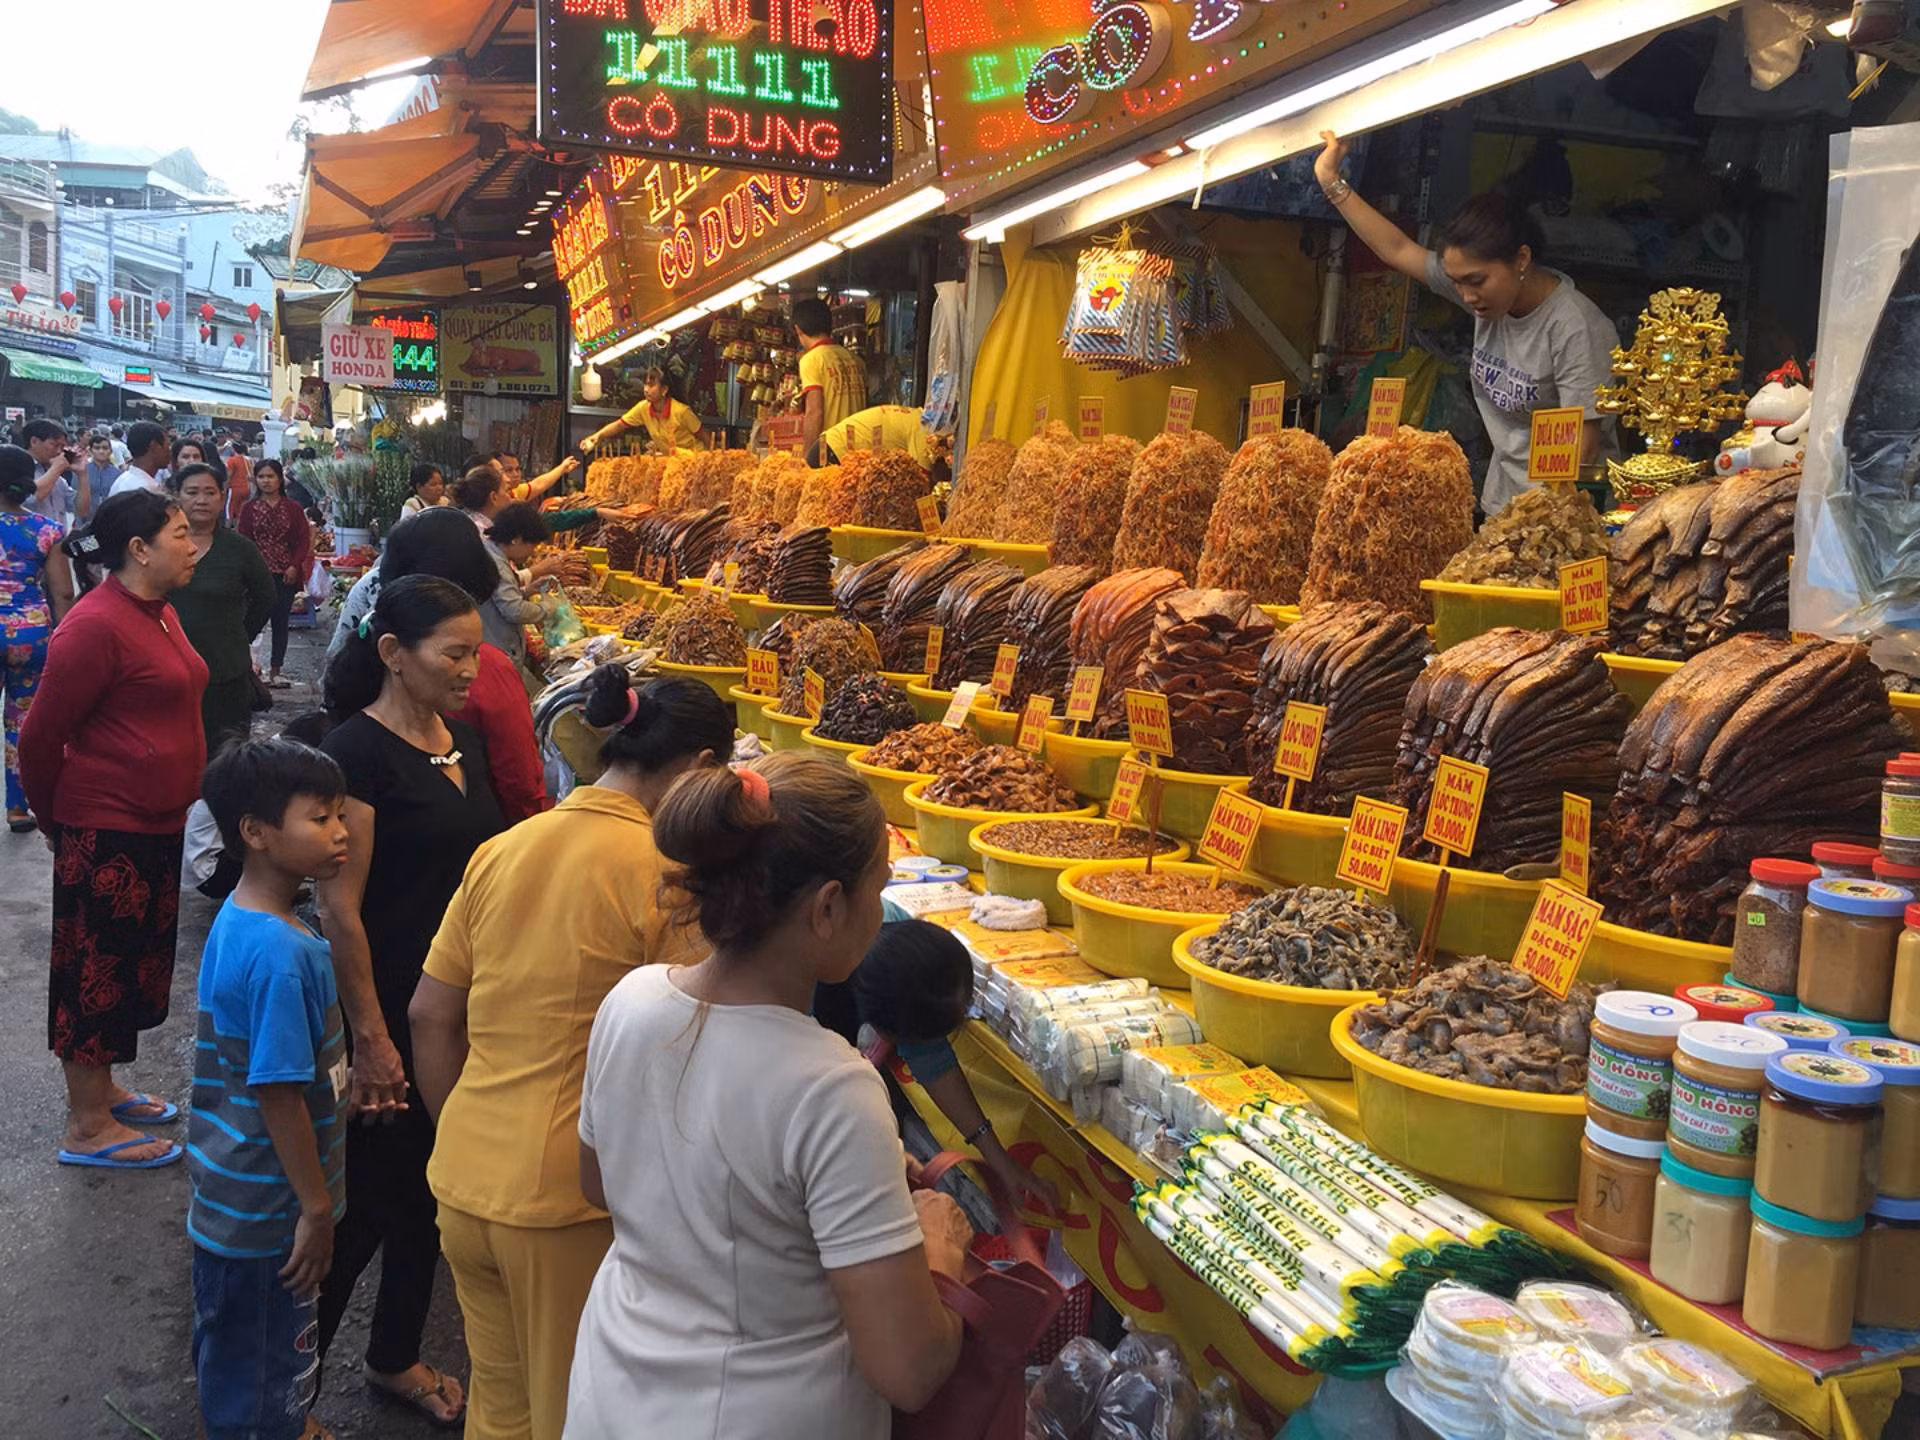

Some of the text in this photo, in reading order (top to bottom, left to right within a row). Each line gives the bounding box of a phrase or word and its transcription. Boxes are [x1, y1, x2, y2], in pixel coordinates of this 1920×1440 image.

[608, 90, 842, 159] CÔ DUNG
[658, 209, 696, 289] CÔ
[364, 337, 386, 360] XE
[331, 361, 386, 378] HONDA
[1474, 362, 1502, 386] EW
[1446, 771, 1474, 795] MẮM
[1536, 892, 1568, 930] MẮM
